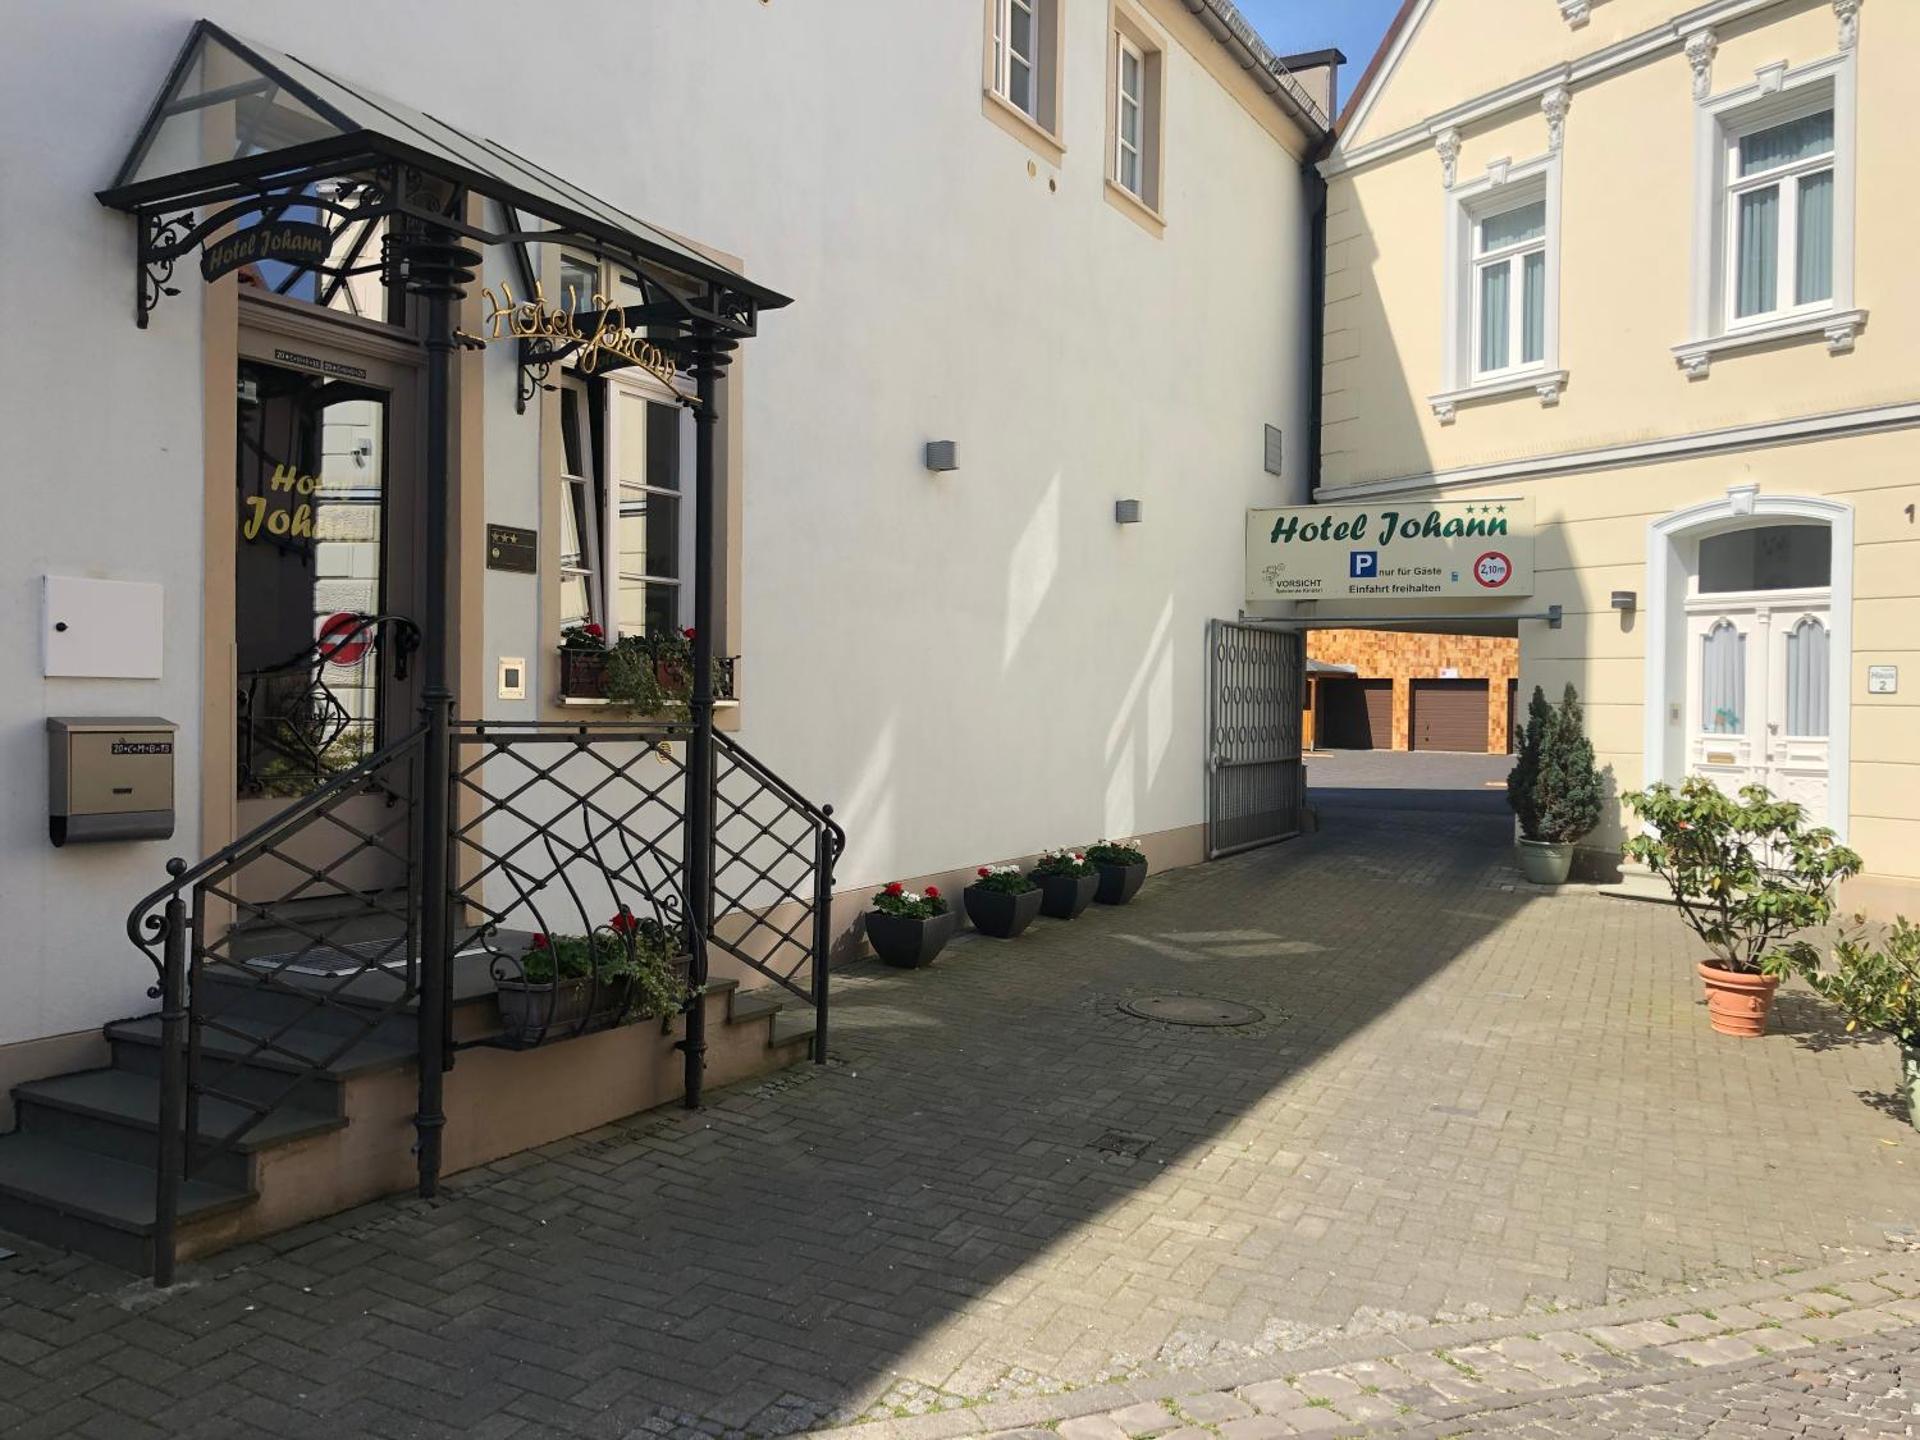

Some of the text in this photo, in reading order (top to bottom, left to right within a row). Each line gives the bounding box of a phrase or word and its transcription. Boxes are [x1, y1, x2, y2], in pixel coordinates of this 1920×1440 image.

[209, 229, 323, 271] Hotel Johann
[481, 279, 676, 384] Hotel Johann
[1270, 510, 1508, 546] Hotel Johann
[1355, 554, 1374, 575] P
[1378, 565, 1442, 577] nur für Gäste
[1276, 579, 1322, 588] VORSICHT
[1349, 584, 1441, 594] Einfahrt freihalten
[1879, 680, 1888, 690] 2
